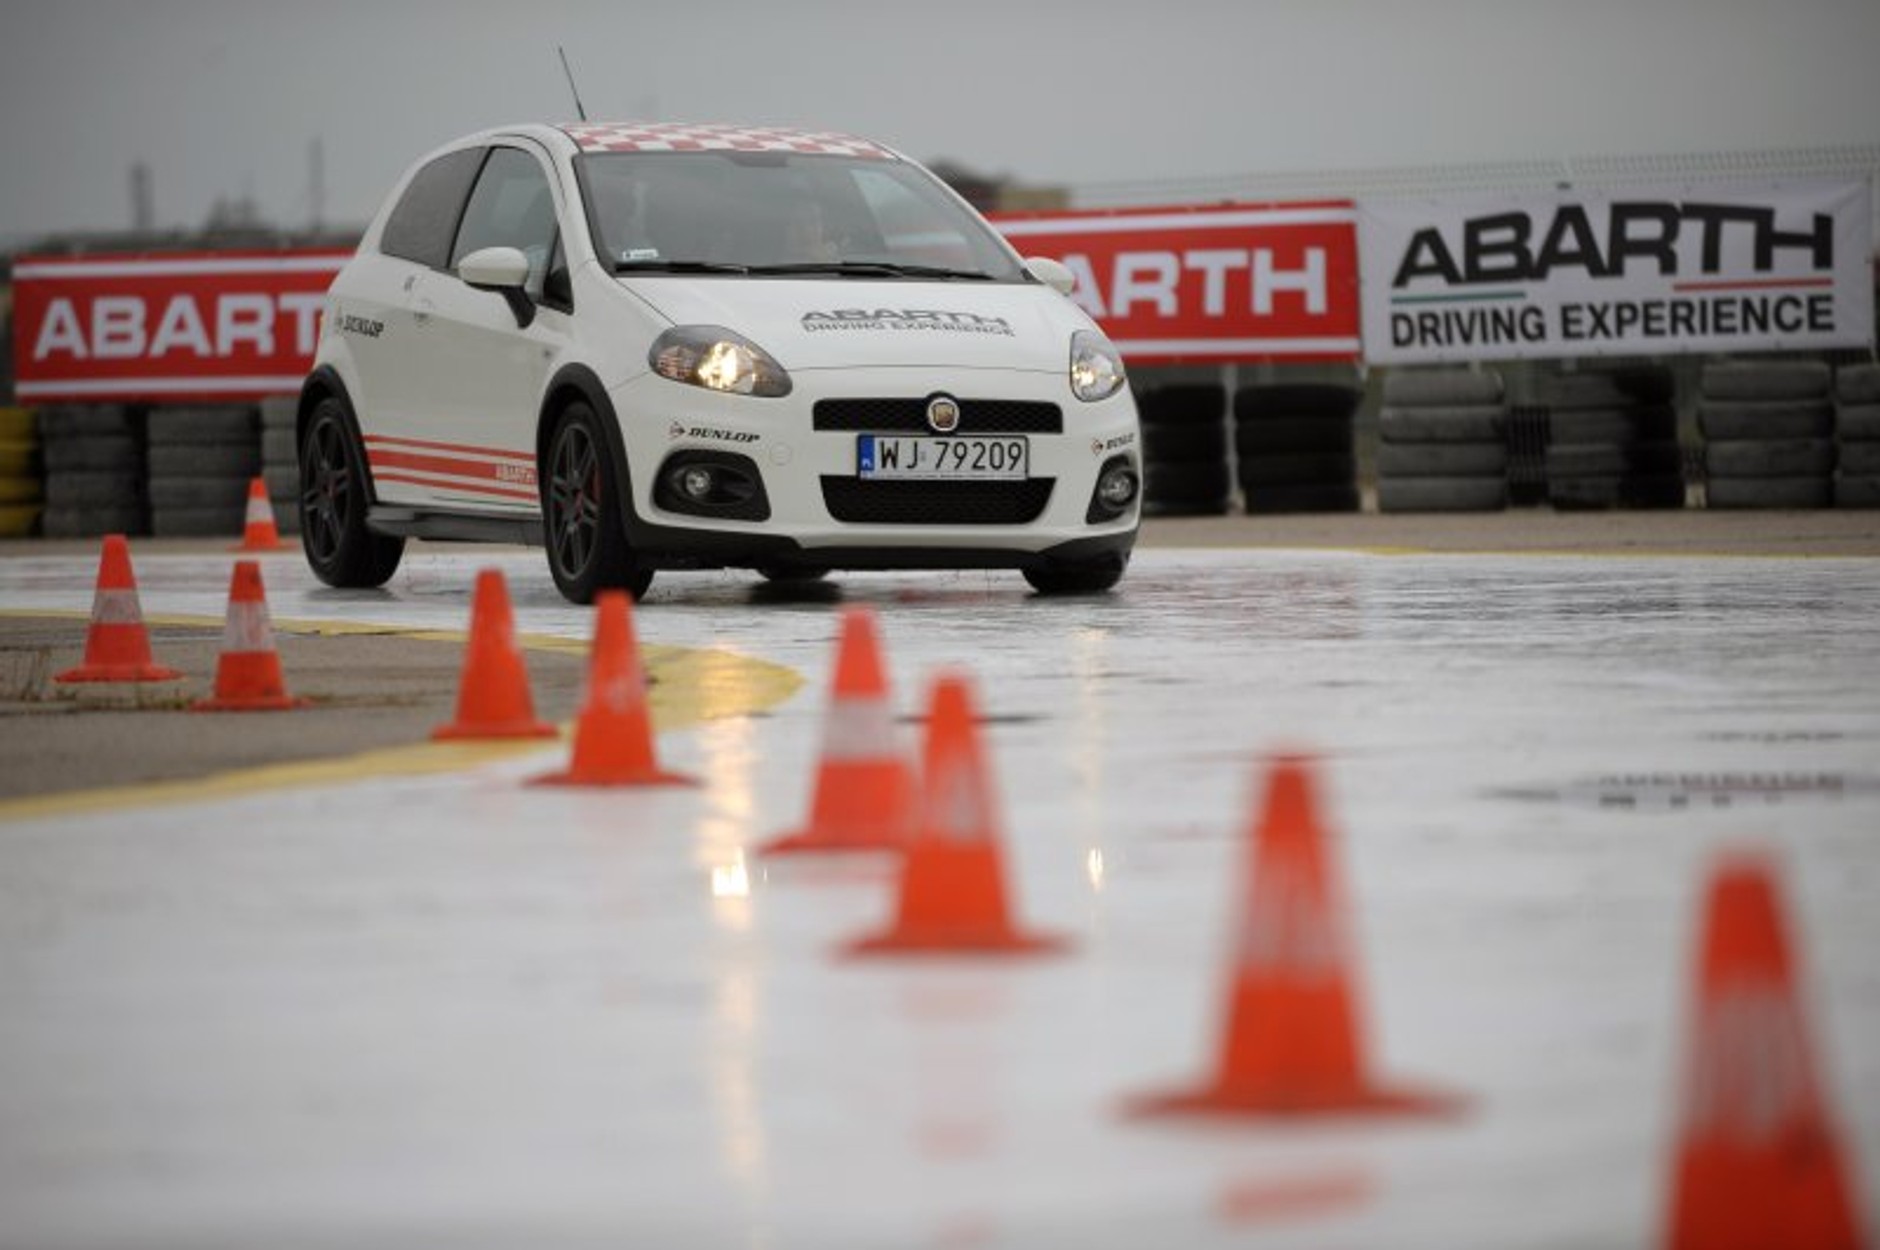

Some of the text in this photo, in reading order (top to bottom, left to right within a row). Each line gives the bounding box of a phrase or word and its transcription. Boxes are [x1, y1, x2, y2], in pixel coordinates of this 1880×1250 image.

[1392, 201, 1834, 289] ABARTH
[1060, 247, 1328, 318] ARTH
[34, 292, 326, 360] ABART
[801, 308, 1008, 327] ABARTH
[1391, 295, 1835, 348] DRIVING EXPERIENCE
[689, 427, 761, 443] DUNLOP
[880, 440, 1023, 471] WJ 79209
